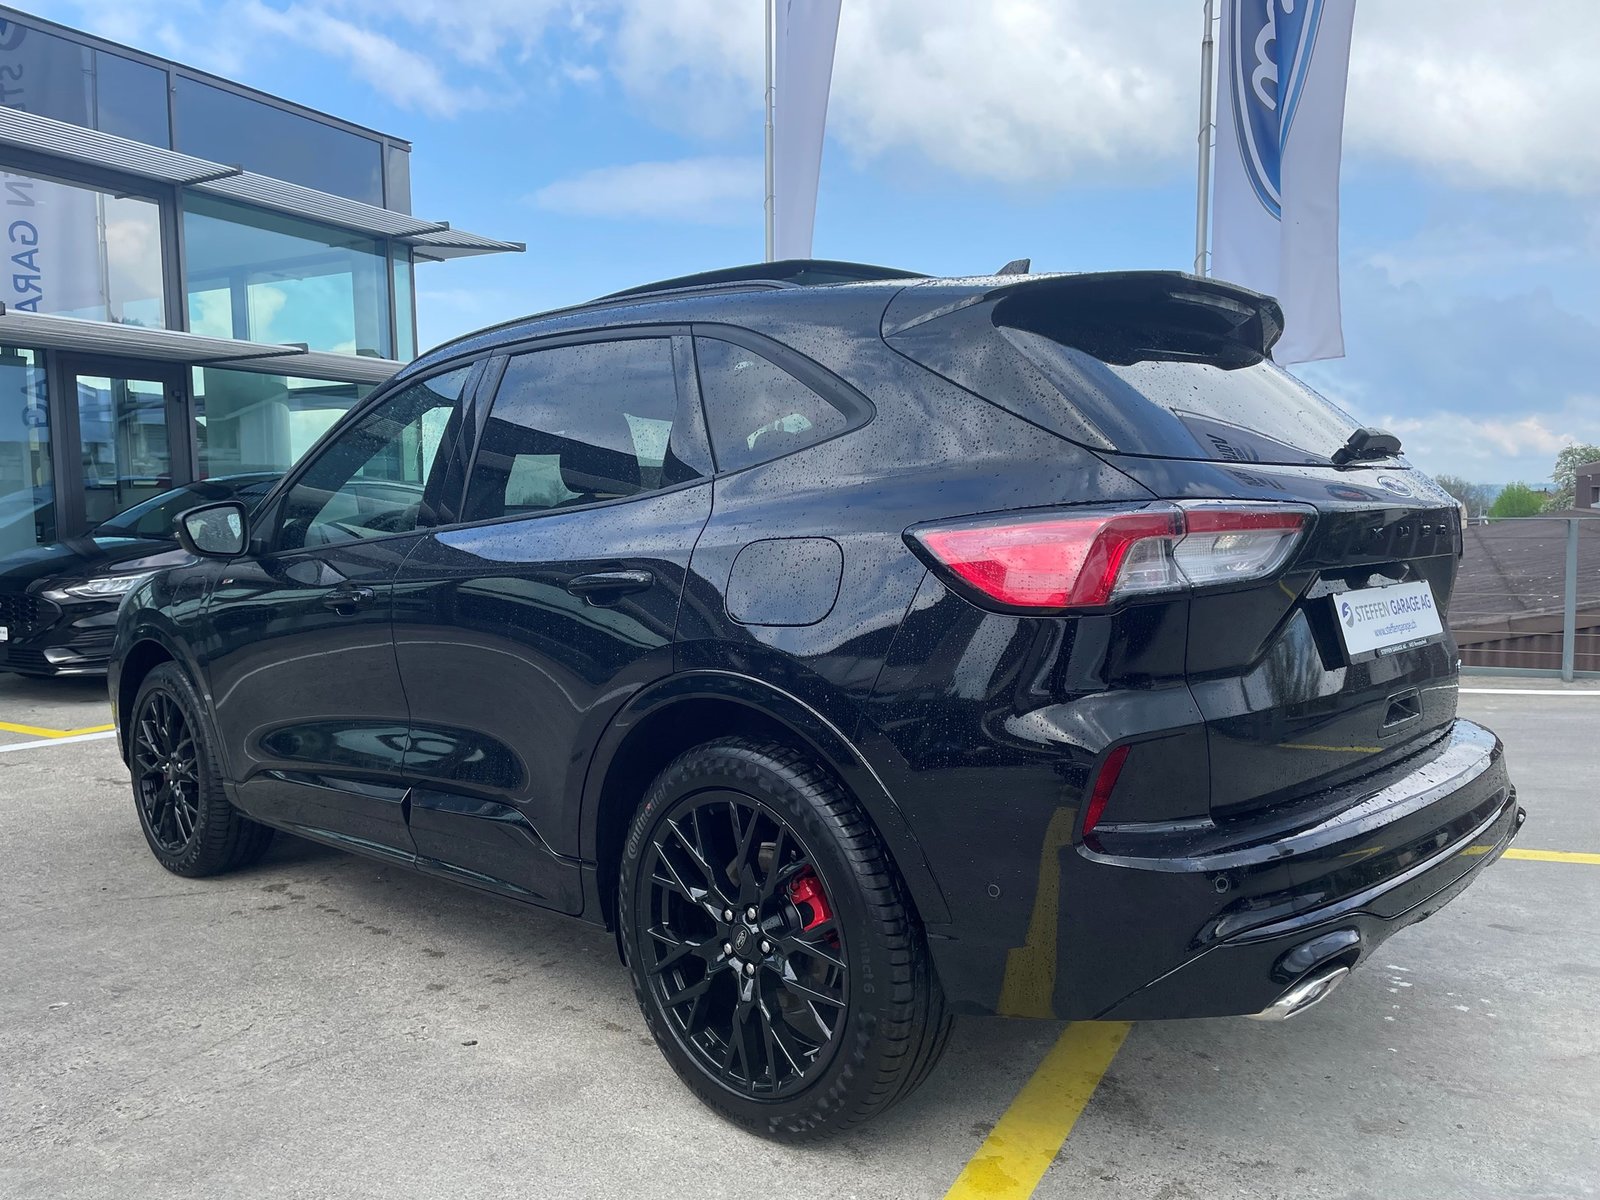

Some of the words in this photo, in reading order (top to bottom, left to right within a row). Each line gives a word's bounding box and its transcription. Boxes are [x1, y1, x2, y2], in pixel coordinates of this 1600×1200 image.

[1355, 601, 1390, 622] STEFFEN
[1390, 596, 1421, 615] GARAGE
[1421, 594, 1432, 609] AG
[627, 783, 666, 860] Continental
